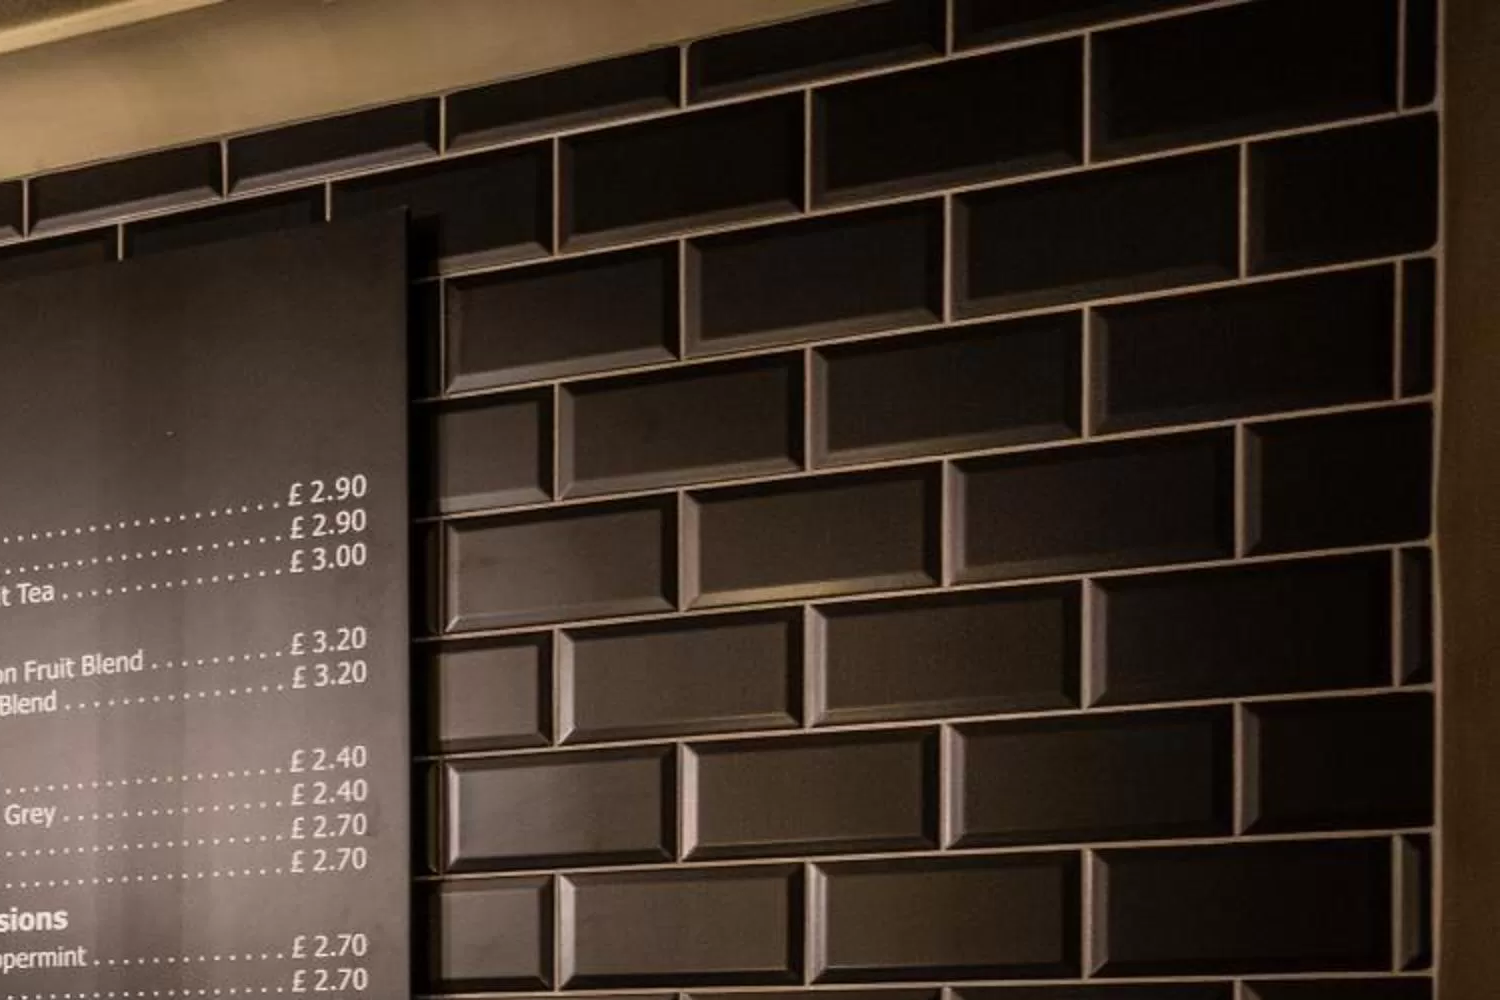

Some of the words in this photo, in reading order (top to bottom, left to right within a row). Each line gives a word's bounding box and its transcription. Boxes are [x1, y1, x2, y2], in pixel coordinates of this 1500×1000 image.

[15, 581, 56, 605] Tea
[23, 657, 76, 683] Fruit
[81, 648, 144, 677] Blend
[3, 803, 57, 829] Grey
